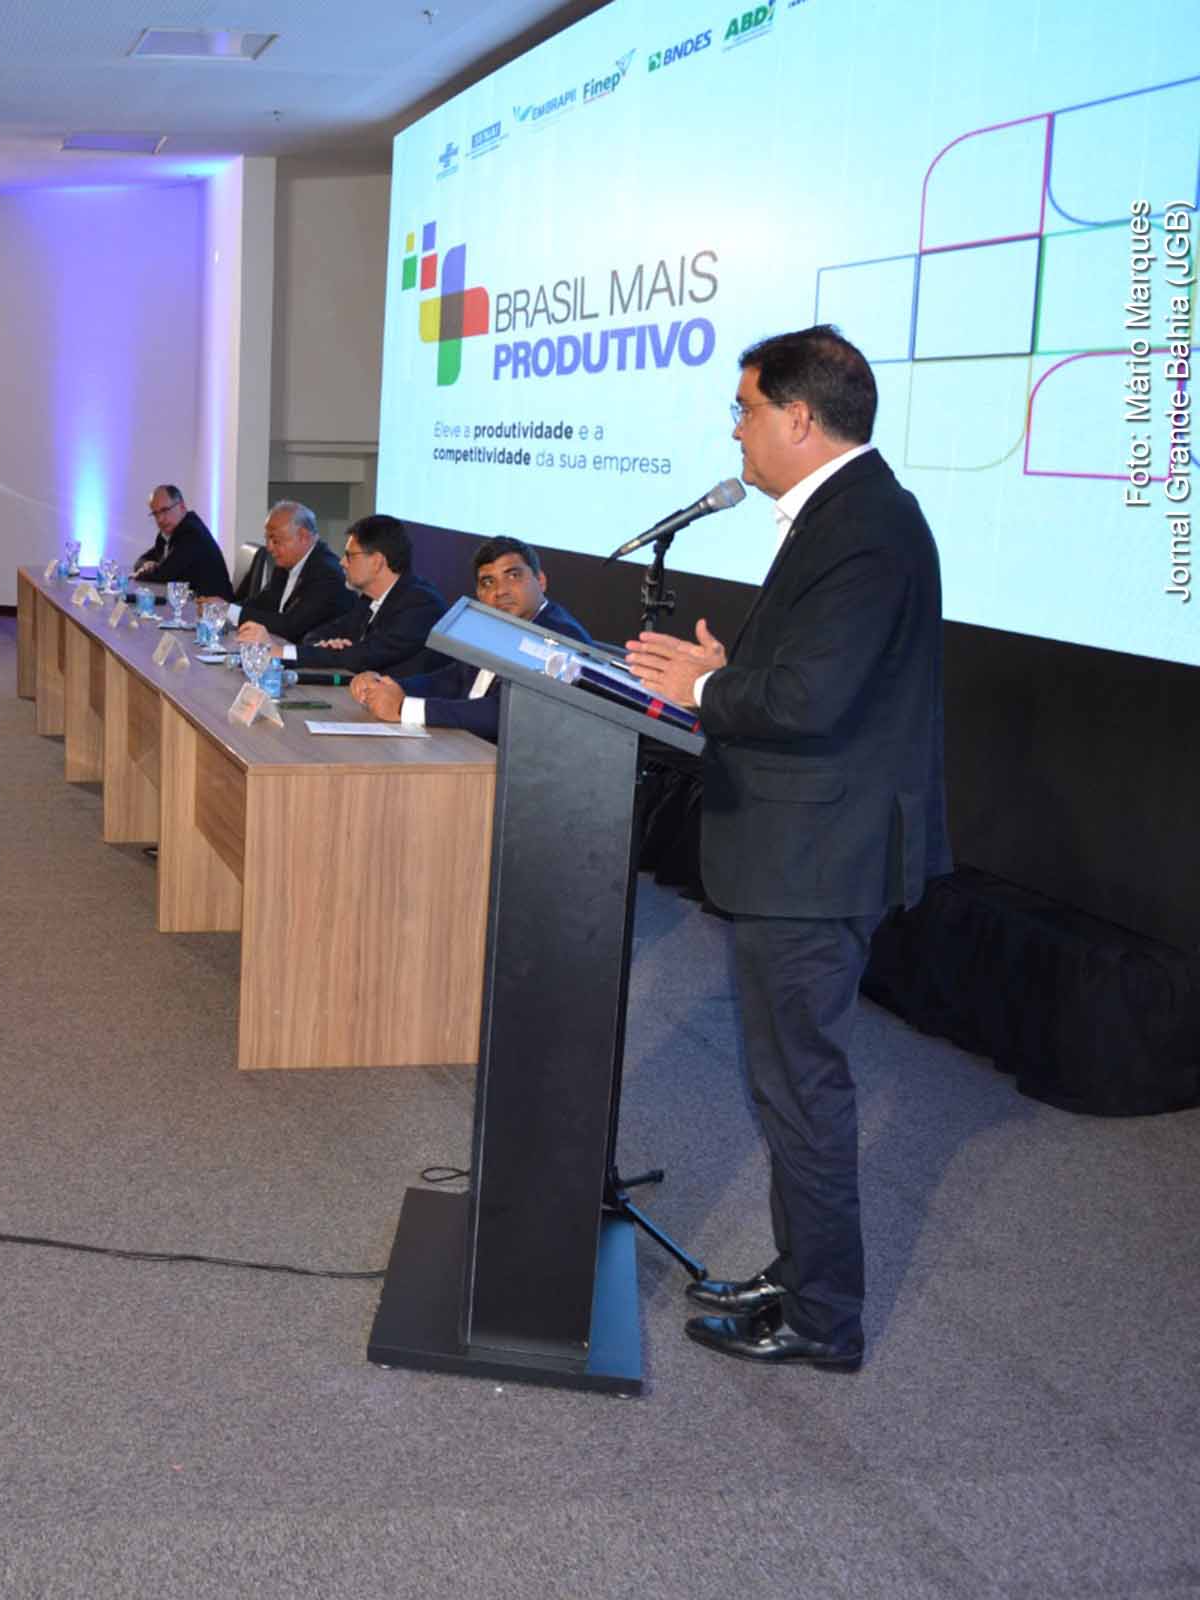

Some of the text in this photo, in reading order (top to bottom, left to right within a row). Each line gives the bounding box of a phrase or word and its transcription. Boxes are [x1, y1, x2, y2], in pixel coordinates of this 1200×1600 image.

[663, 30, 712, 65] BNDES
[583, 72, 620, 100] Finep
[495, 250, 718, 333] BRASIL MAIS
[493, 317, 716, 381] PRODUTIVO
[433, 420, 461, 438] Eleve
[473, 420, 573, 440] produtividade
[578, 425, 588, 440] e
[594, 425, 604, 440] a
[433, 446, 672, 476] competitividade da sua empresa
